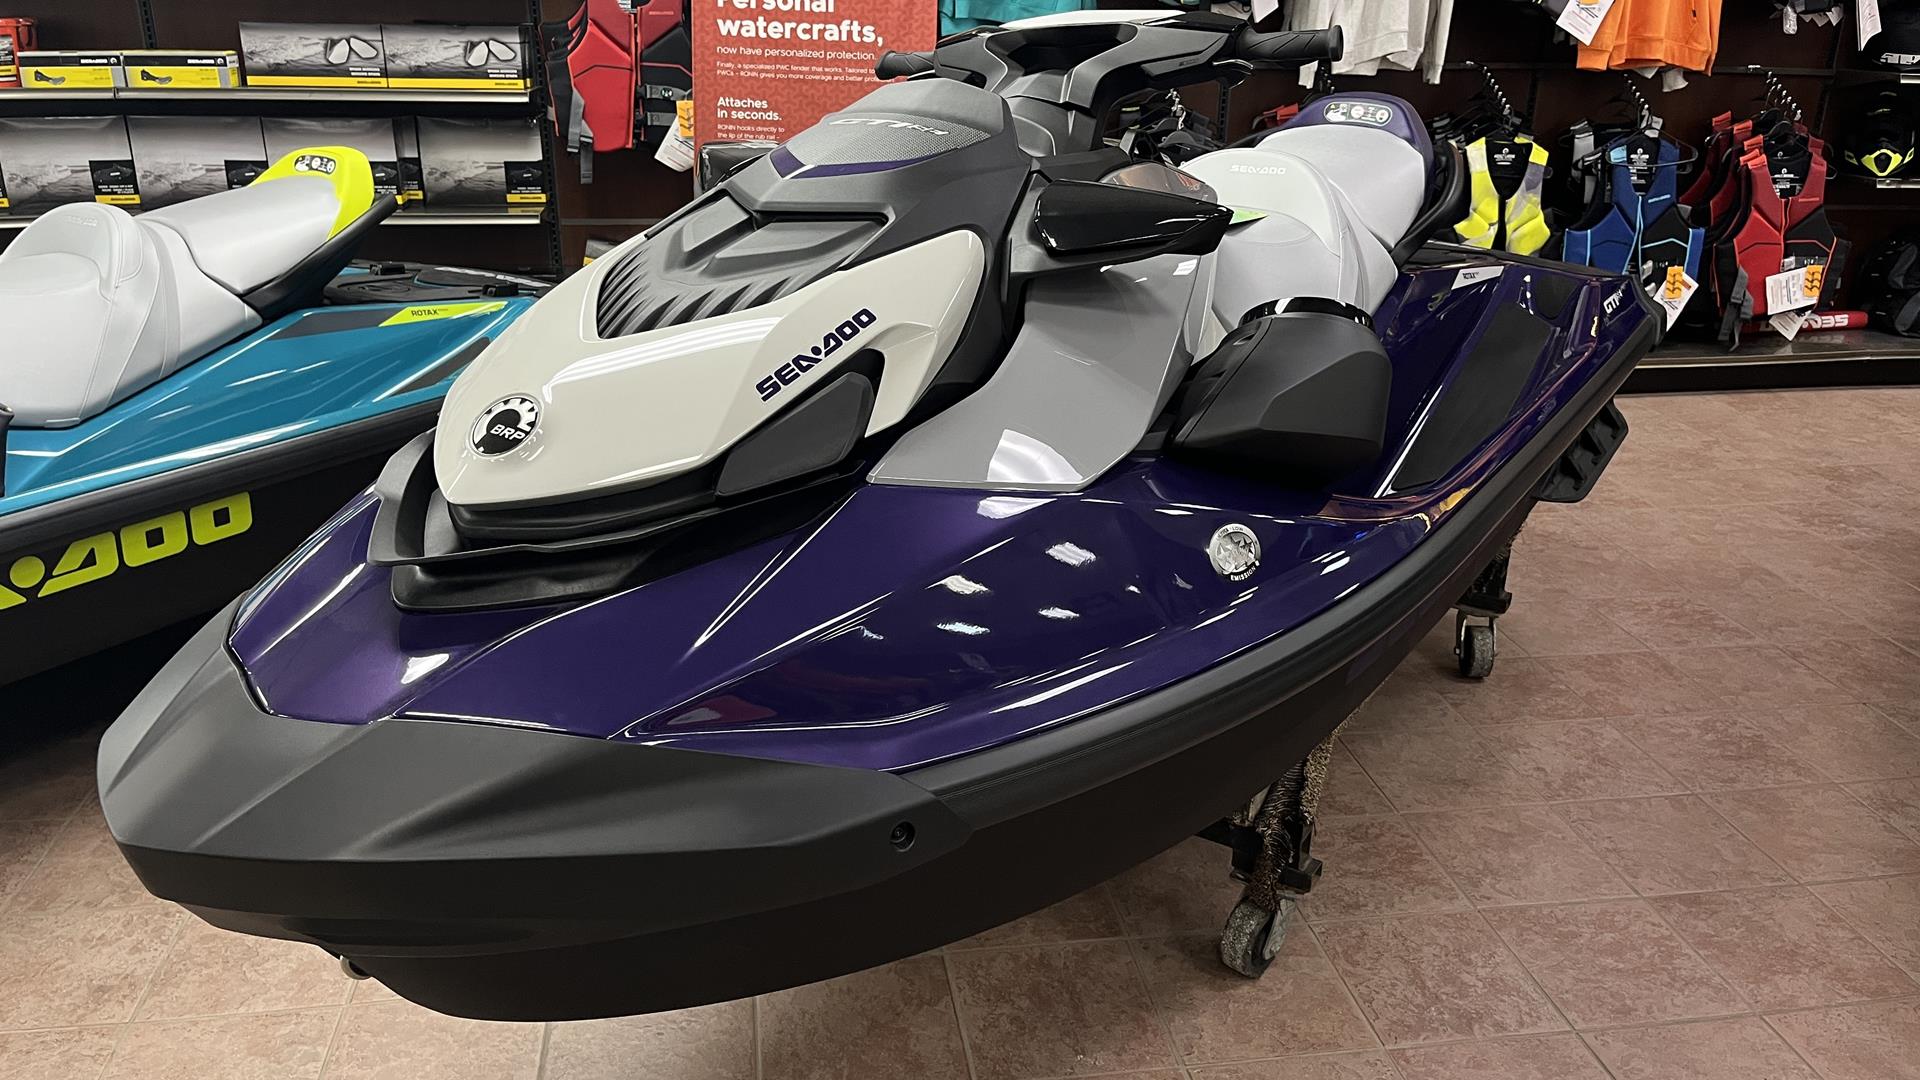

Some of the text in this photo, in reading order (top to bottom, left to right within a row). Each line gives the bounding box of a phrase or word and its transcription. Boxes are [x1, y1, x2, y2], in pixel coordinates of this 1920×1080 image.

[716, 16, 883, 47] watercrafts,
[716, 46, 879, 60] now have personalized protection.
[717, 96, 768, 109] Attaches
[731, 110, 782, 121] seconds.
[411, 308, 439, 317] ROTAX
[490, 423, 526, 440] BRP
